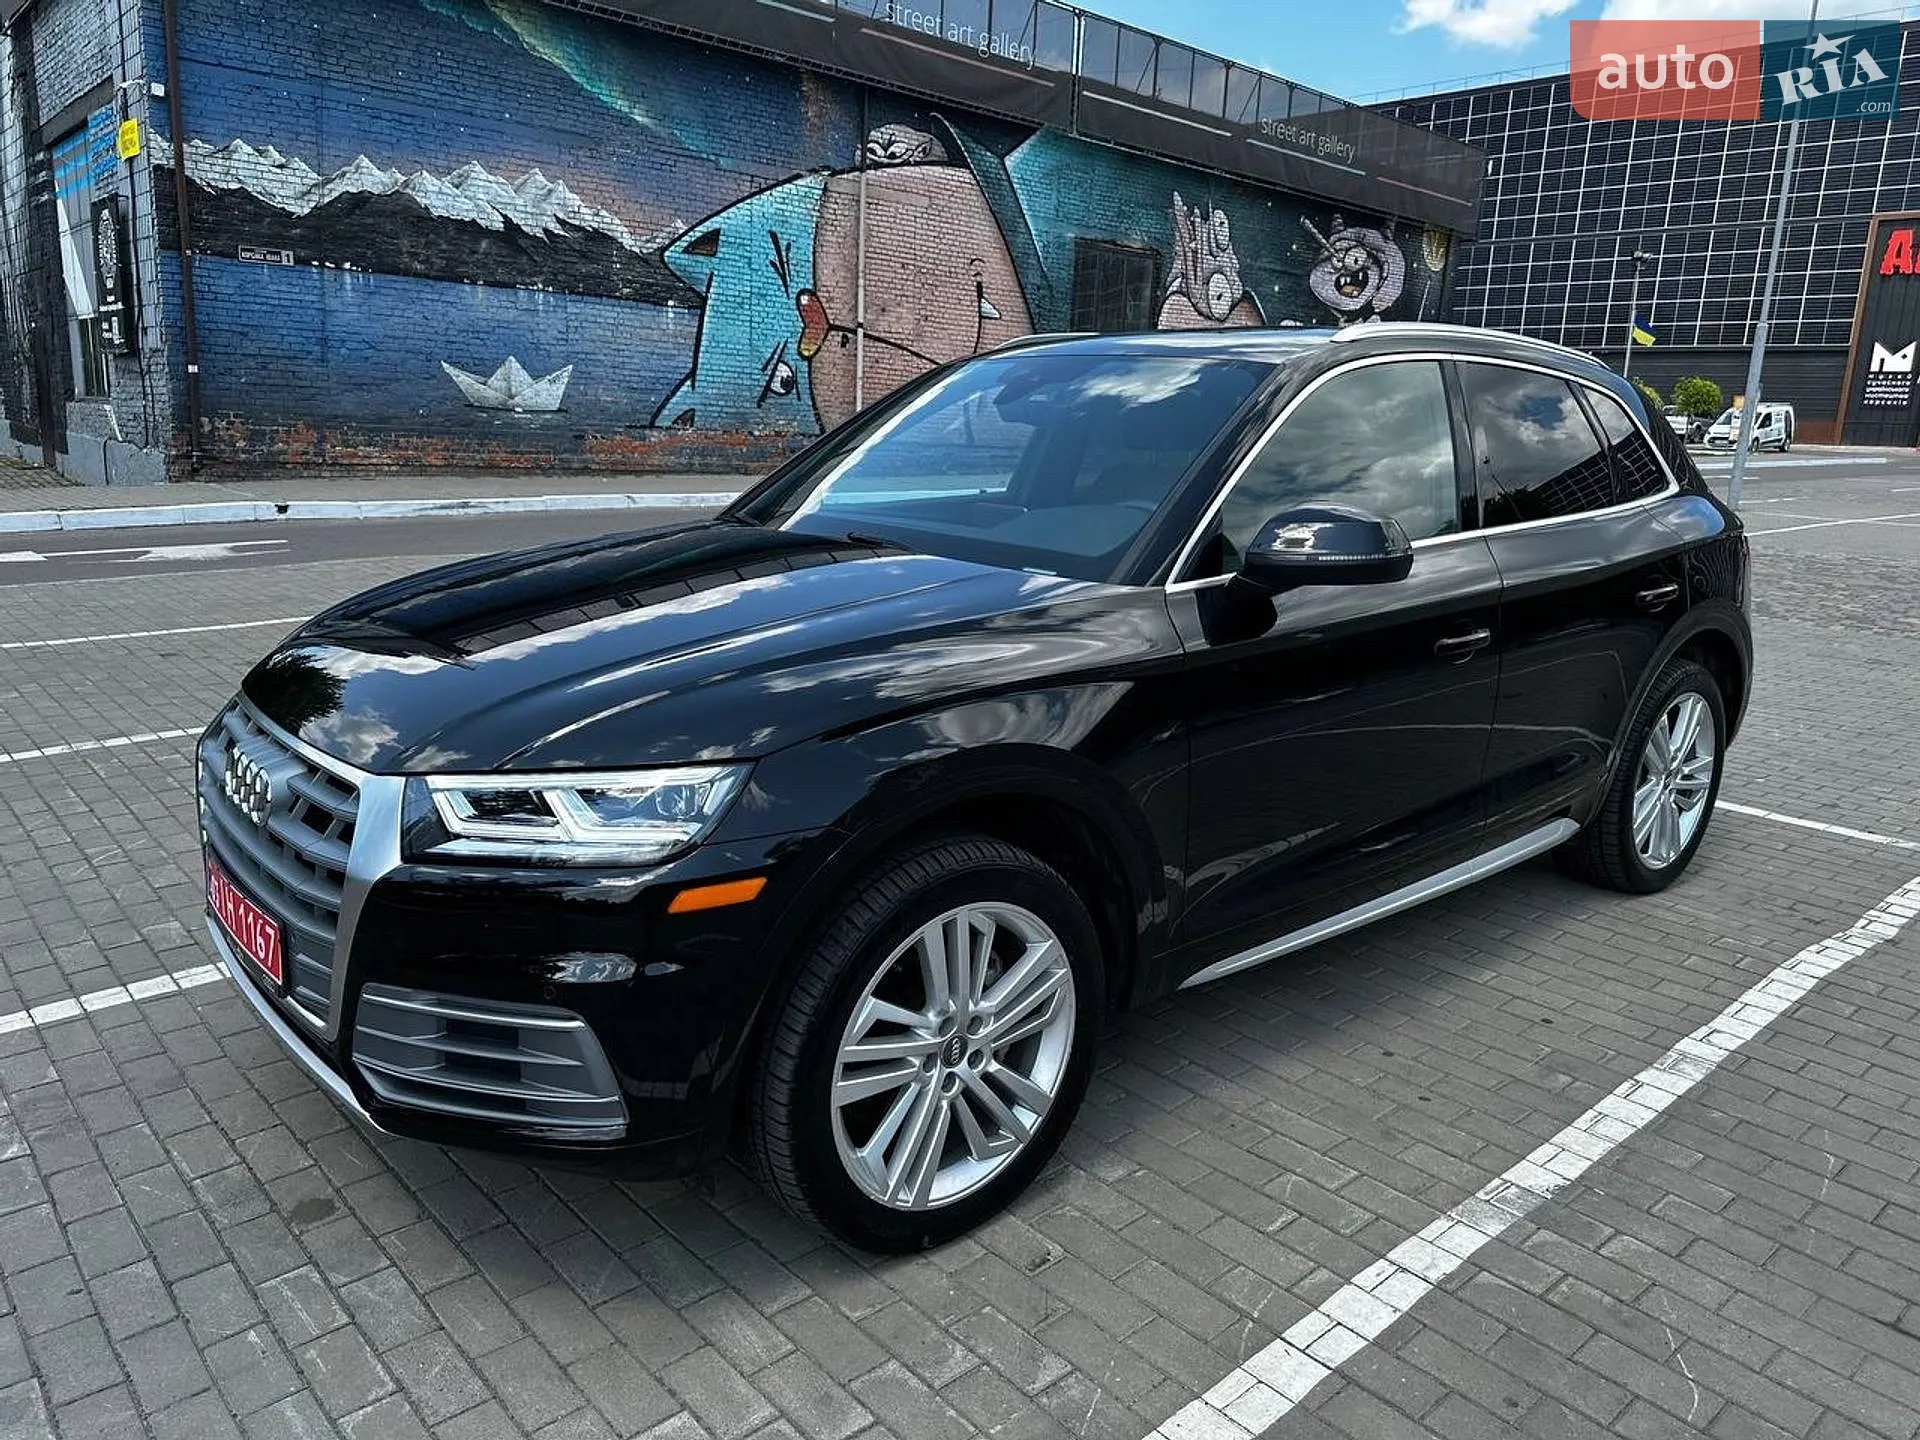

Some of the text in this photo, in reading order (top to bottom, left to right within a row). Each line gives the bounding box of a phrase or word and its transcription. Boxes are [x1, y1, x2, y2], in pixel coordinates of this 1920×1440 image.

[886, 3, 1034, 71] street art gallery
[1261, 118, 1356, 164] street art gallery
[1879, 229, 1920, 275] A
